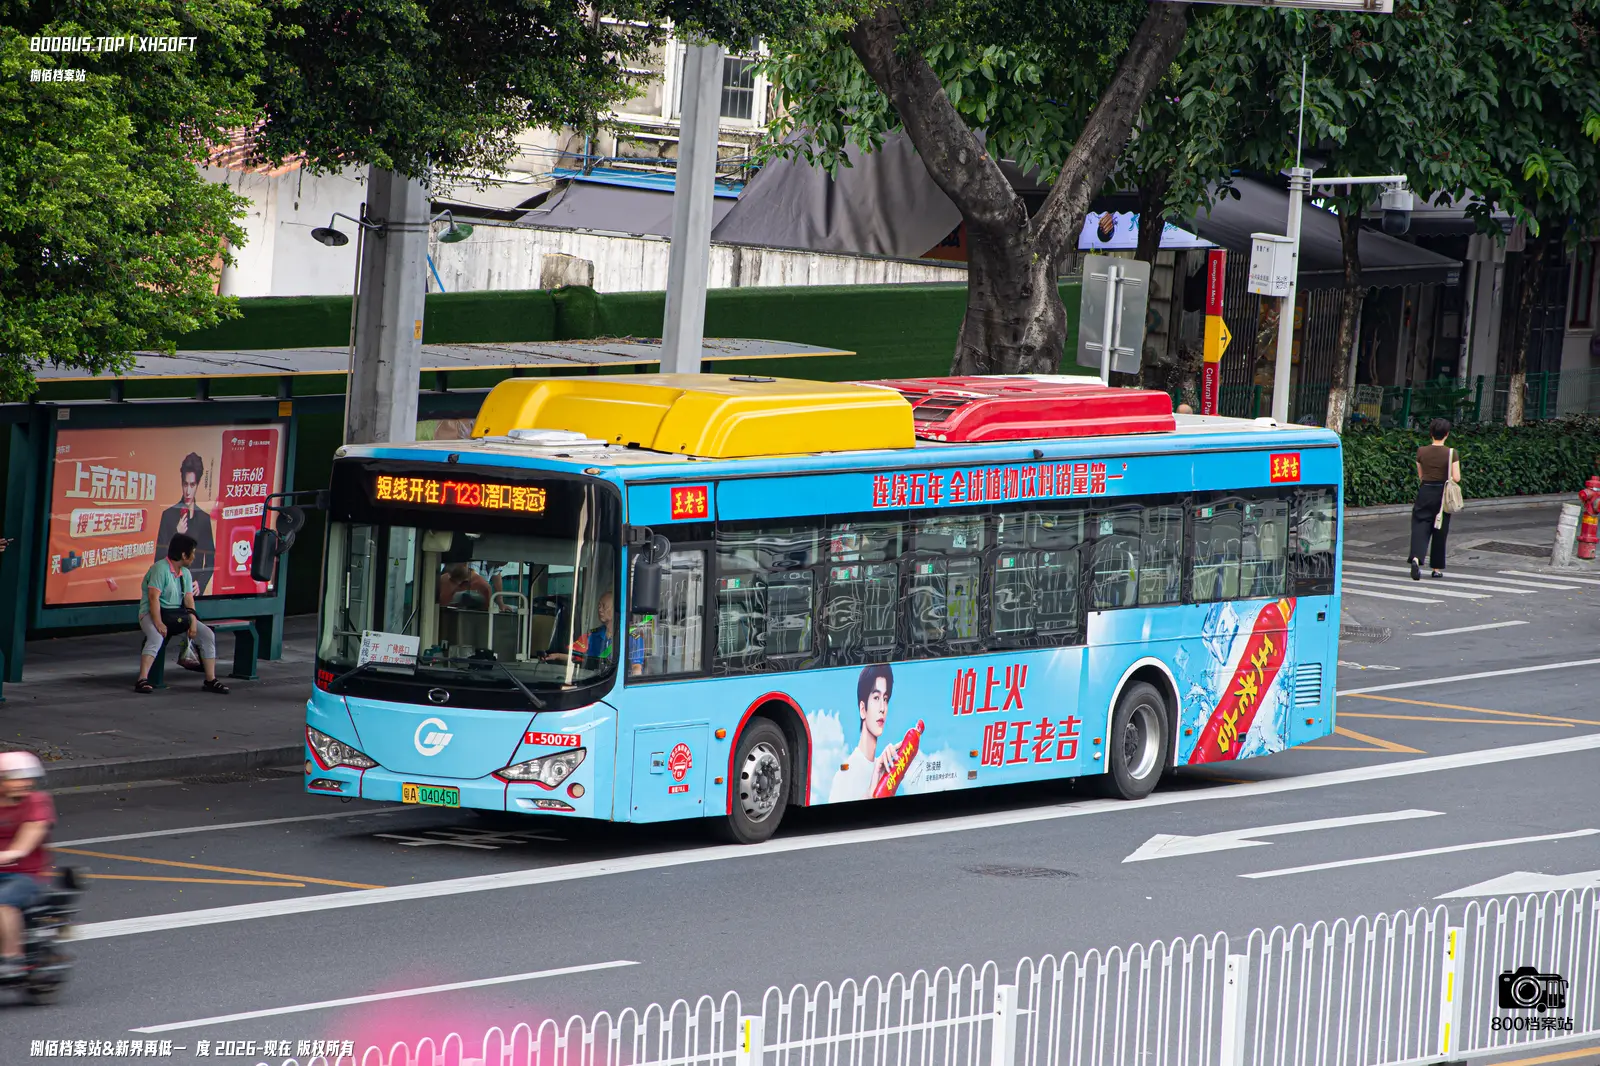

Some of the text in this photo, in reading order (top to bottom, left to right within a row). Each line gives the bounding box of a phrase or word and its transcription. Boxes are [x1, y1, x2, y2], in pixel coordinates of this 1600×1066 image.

[1204, 367, 1214, 416] Cultural Par
[65, 462, 156, 500] 上京东618
[232, 467, 264, 482] 京东618
[1272, 457, 1299, 479] 王老吉
[225, 483, 268, 498] 又好又便宜
[673, 491, 706, 515] 王老吉
[872, 472, 944, 509] 连续五年
[952, 664, 1029, 716] 怕上火
[528, 733, 578, 746] 1-50073
[981, 715, 1082, 767] 喝王老吉
